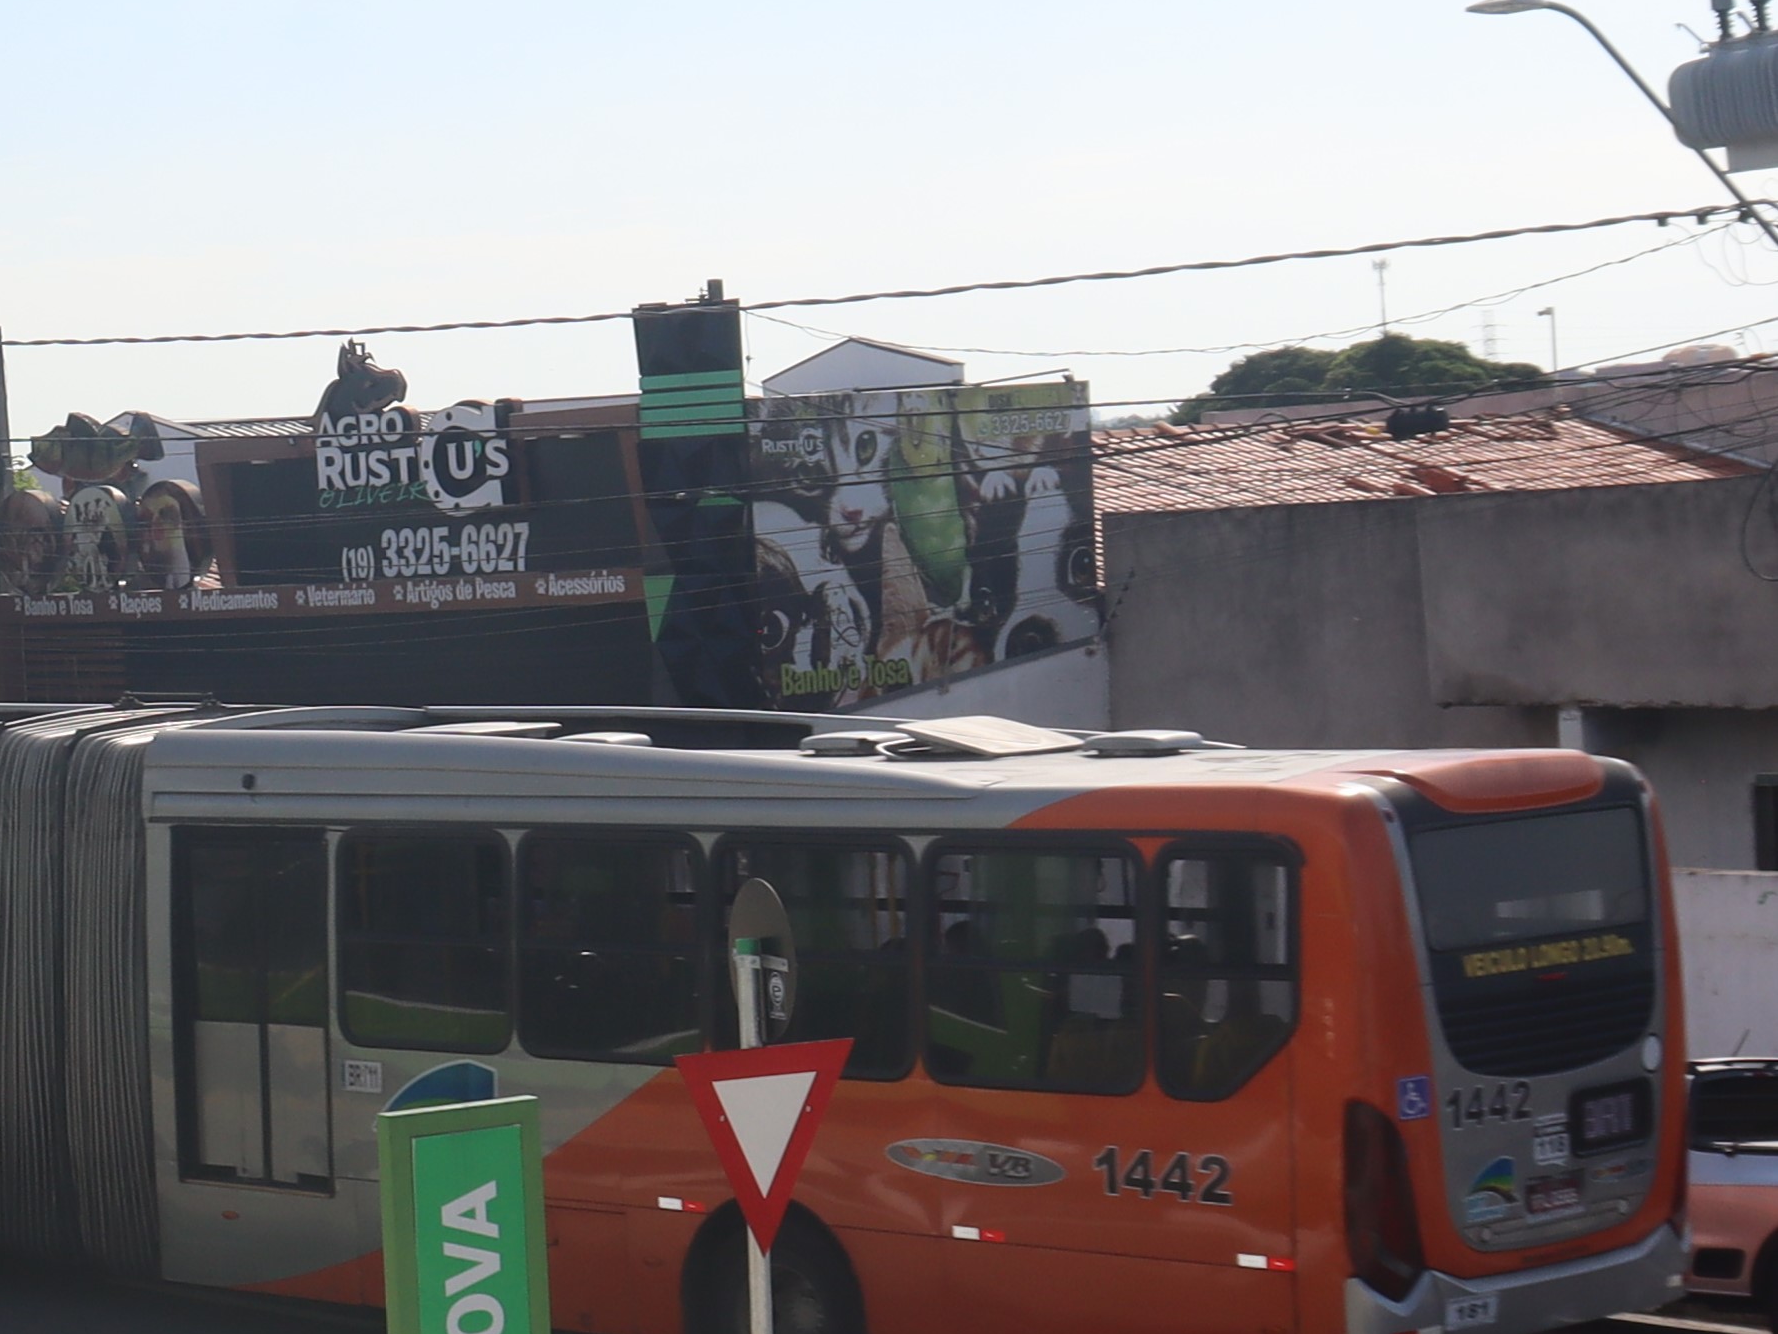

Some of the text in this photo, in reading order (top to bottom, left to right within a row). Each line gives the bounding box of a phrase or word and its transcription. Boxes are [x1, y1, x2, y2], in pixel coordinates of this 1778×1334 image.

[316, 410, 404, 448] AGRO
[992, 410, 1072, 438] 3325-6627
[341, 522, 530, 582] (19) 3325-6627
[23, 570, 626, 618] Banho e Tosa Rações Medicamentos Veterinário Artigos de Pesca Acessórios
[781, 653, 911, 696] Banho e Tosa
[1445, 1079, 1533, 1131] 1442
[986, 1150, 1034, 1178] VB
[1094, 1144, 1234, 1206] 1442
